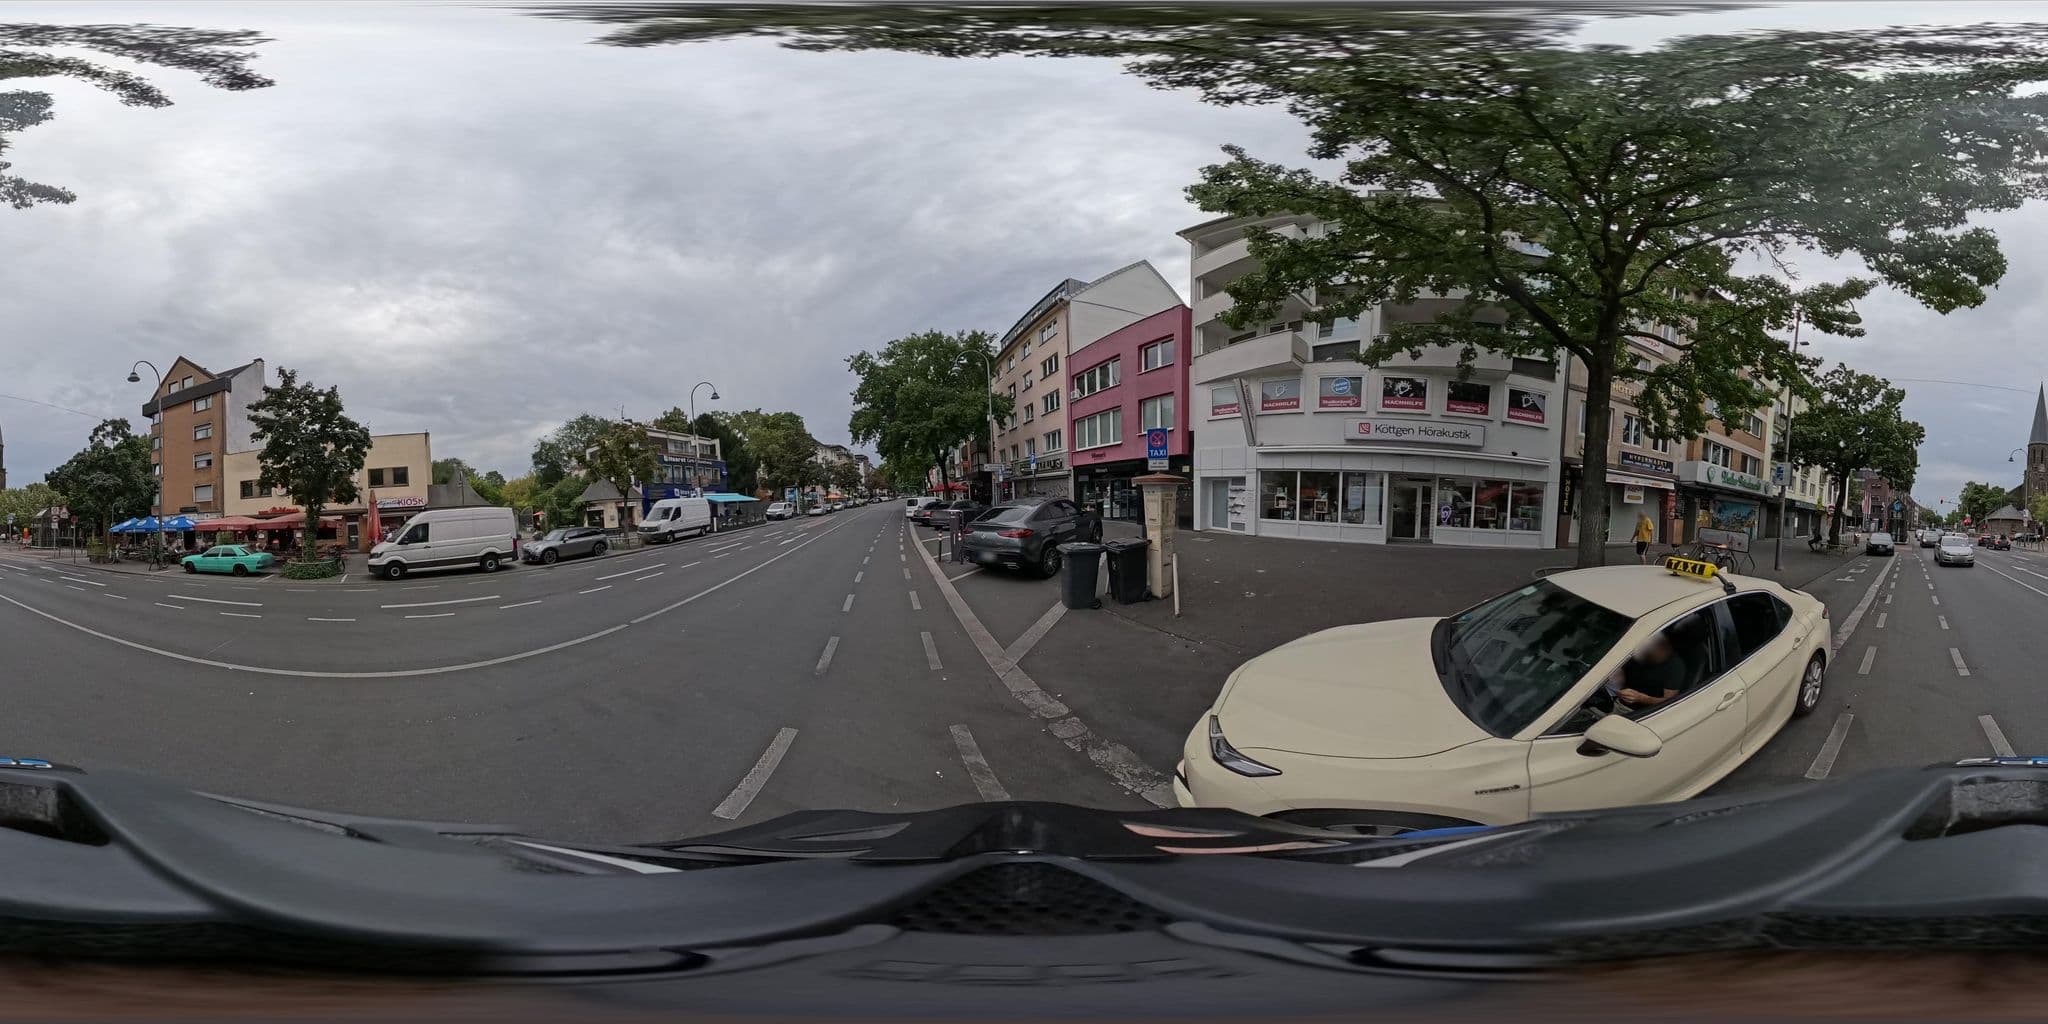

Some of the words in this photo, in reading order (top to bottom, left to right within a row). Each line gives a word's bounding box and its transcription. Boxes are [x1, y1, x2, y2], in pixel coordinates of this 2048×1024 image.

[1384, 399, 1424, 407] NACHHILFE
[1509, 410, 1543, 420] NACHHILFE
[1375, 424, 1415, 437] Köttgen
[1418, 427, 1471, 439] Hörakustik
[1149, 449, 1167, 457] TAXI
[398, 497, 424, 506] KIOSK
[1671, 560, 1701, 574] TAXI
